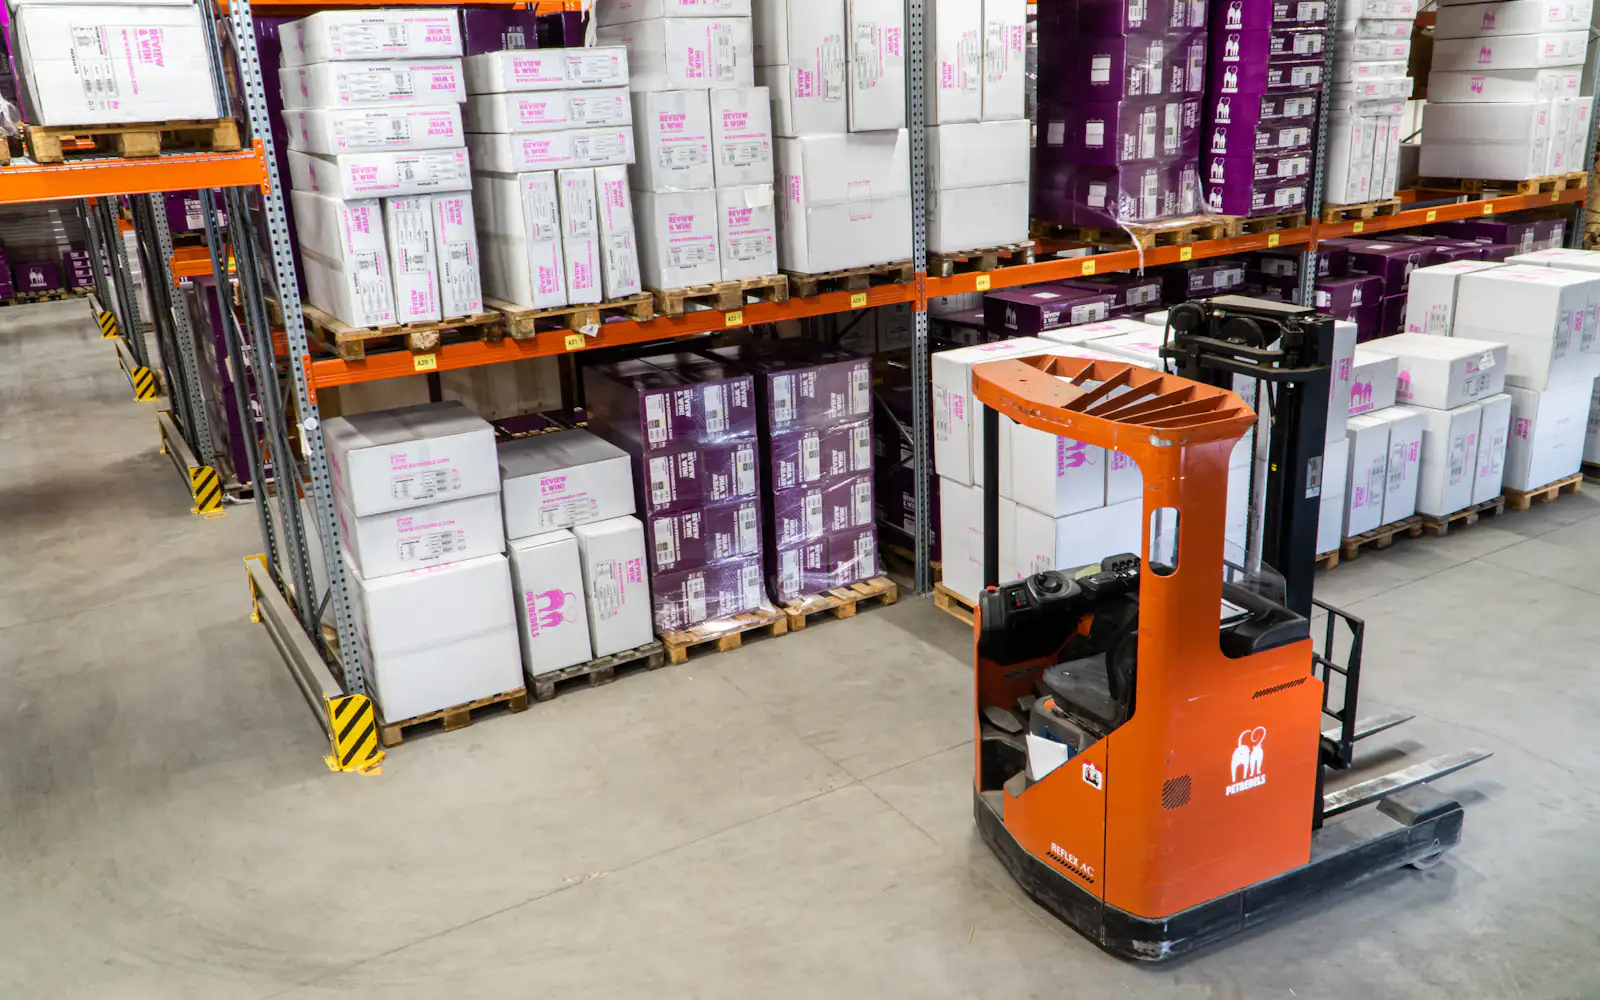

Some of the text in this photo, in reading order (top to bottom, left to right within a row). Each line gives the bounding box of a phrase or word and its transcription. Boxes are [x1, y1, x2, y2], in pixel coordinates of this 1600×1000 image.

[141, 40, 153, 64] WIN!
[149, 29, 164, 67] REVIEW
[513, 60, 542, 68] REVIEW
[659, 114, 686, 122] REVIEW
[666, 121, 684, 129] WIN!
[723, 112, 748, 120] REVIEW
[729, 119, 746, 127] WIN!
[668, 215, 694, 223] REVIEW
[728, 208, 753, 217] REVIEW
[683, 389, 692, 418] REVIEW
[734, 389, 742, 407] WIN!
[740, 380, 748, 408] REVIEW
[687, 451, 696, 479] REVIEW
[540, 475, 567, 487] REVIEW
[548, 483, 565, 492] WIN!
[712, 473, 720, 501] REVIEW
[691, 512, 700, 539] REVIEW
[525, 590, 540, 638] PETREBELS
[1226, 774, 1266, 796] PETREBELS
[1051, 842, 1095, 877] REFLEX AC
